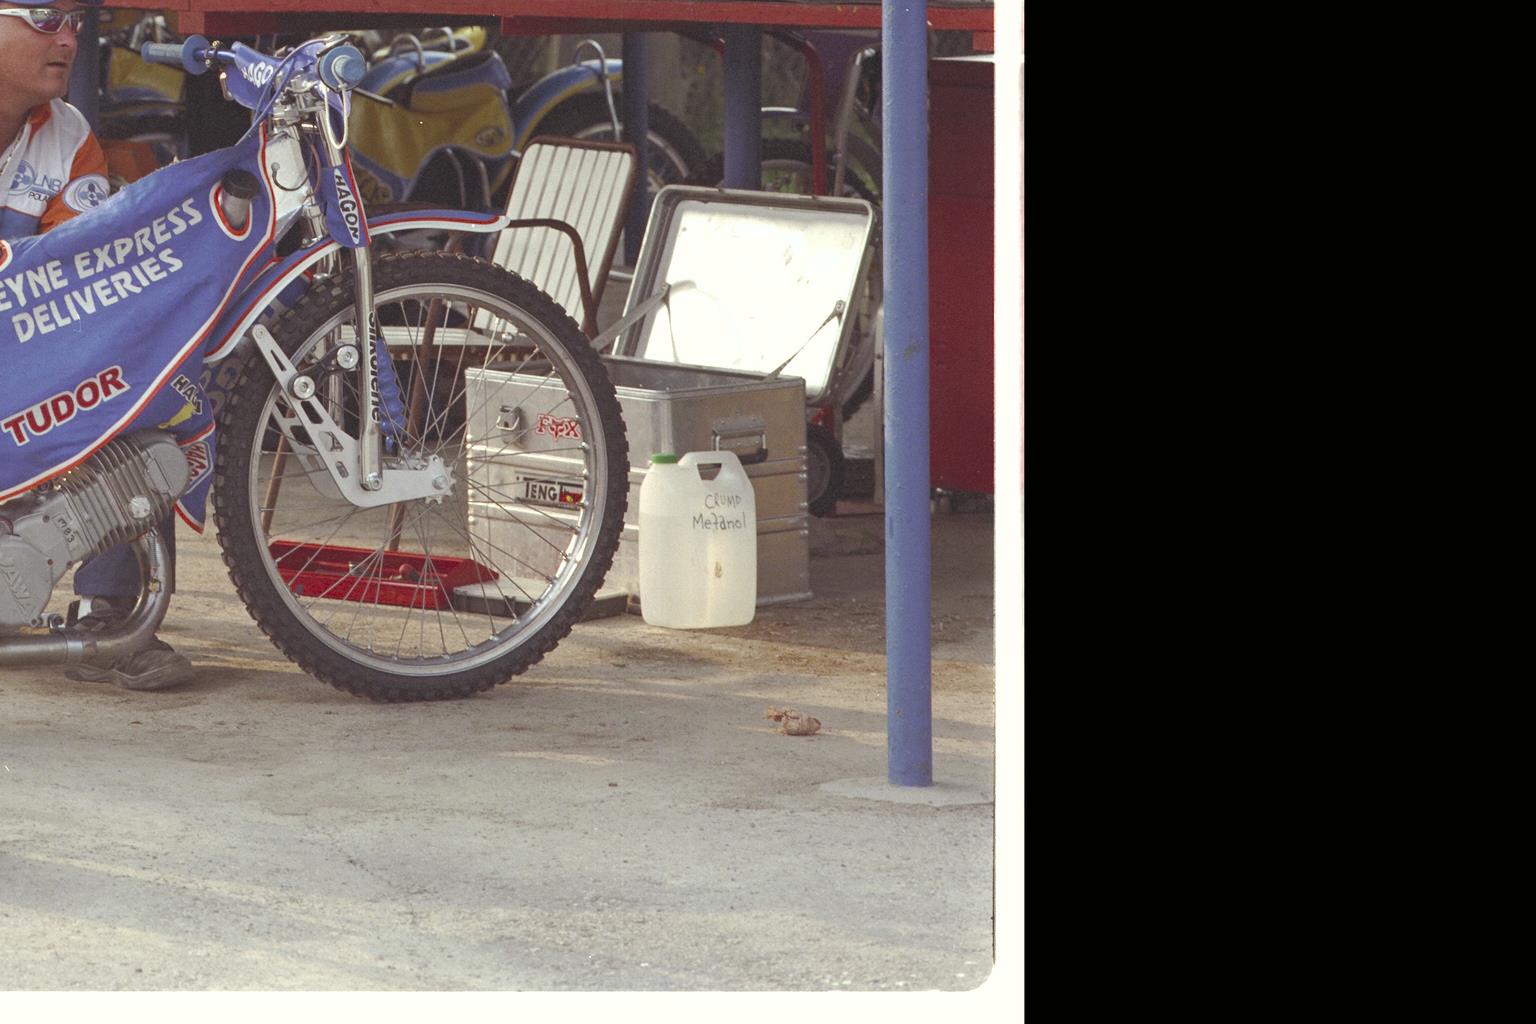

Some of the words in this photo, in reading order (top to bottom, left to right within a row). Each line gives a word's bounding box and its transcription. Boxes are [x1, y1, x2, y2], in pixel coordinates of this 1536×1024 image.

[35, 175, 63, 192] LNB
[335, 174, 360, 241] HAGON
[73, 198, 203, 279] EXPRESS
[11, 247, 183, 343] DELIVERIES
[4, 368, 126, 444] TUDOR
